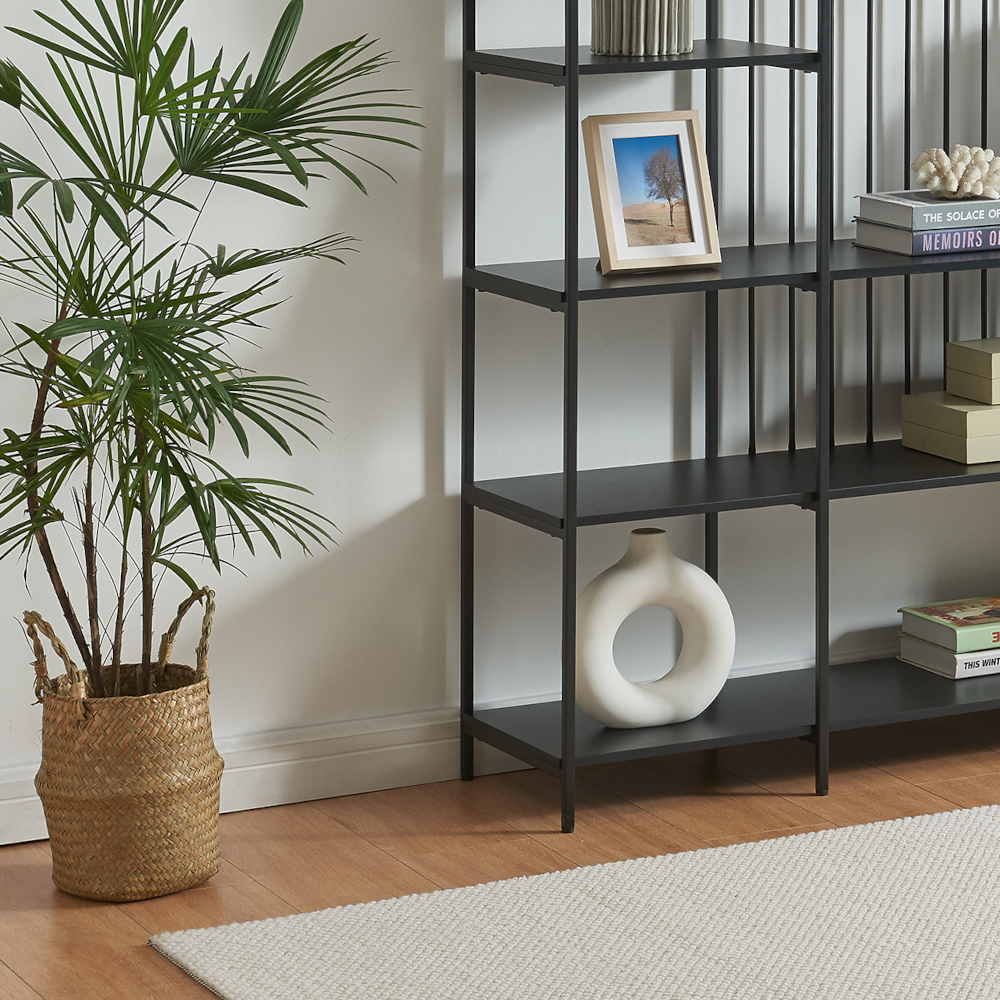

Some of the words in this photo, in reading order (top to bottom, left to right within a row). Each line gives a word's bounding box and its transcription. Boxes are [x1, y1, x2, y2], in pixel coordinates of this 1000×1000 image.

[923, 212, 943, 223] THE
[946, 210, 985, 222] SOLACE
[922, 230, 983, 252] MEMOIRS
[963, 659, 981, 671] THIS
